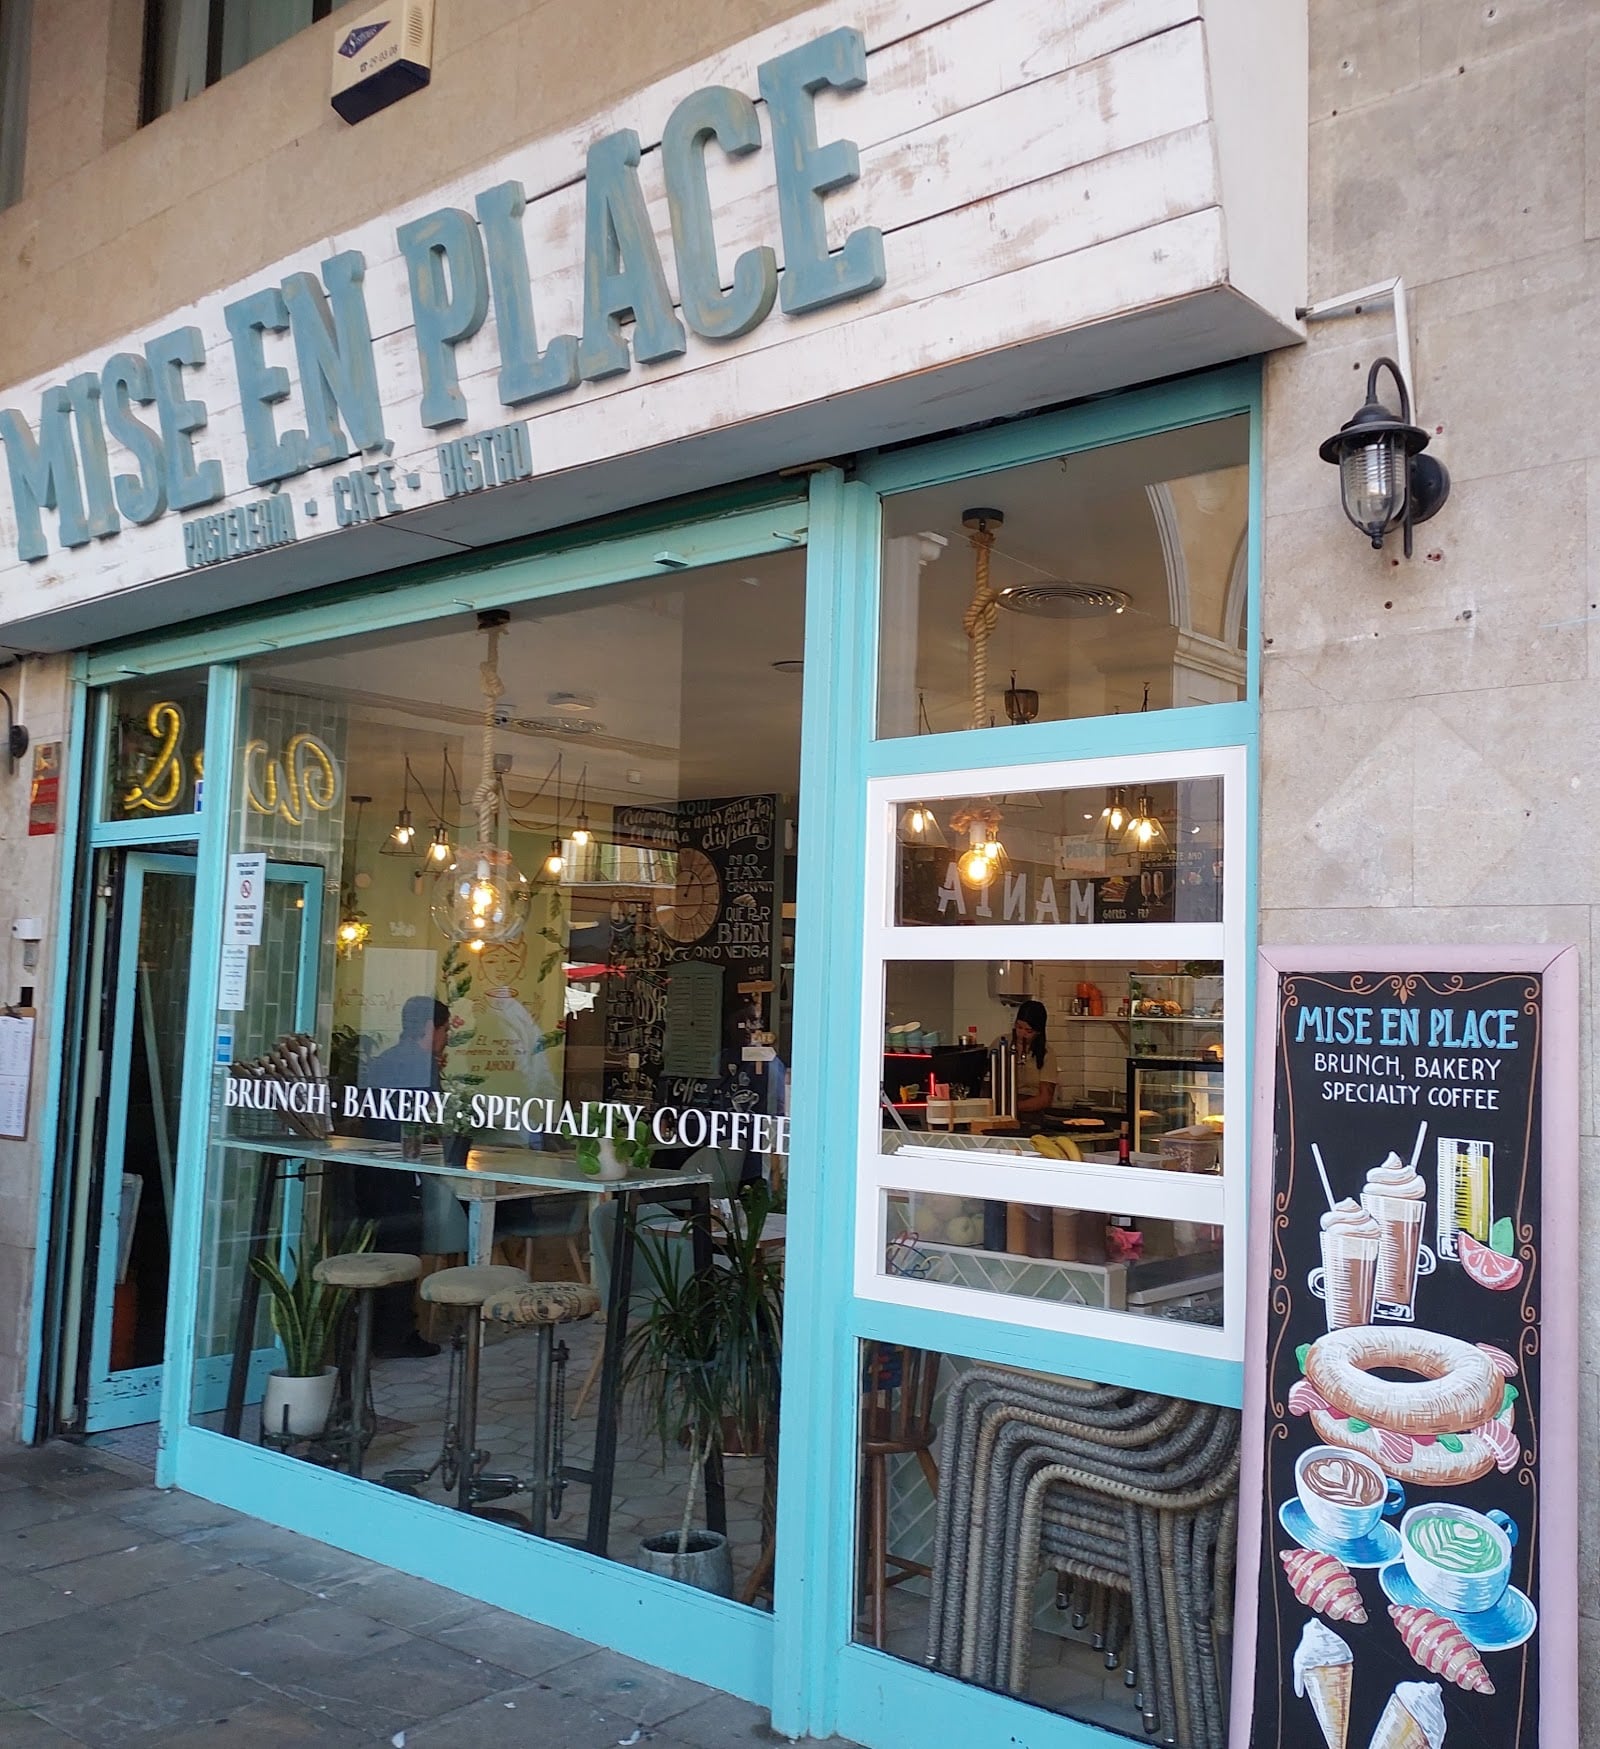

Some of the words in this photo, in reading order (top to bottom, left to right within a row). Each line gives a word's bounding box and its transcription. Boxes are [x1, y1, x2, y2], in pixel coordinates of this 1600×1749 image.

[0, 326, 224, 562] MISE
[224, 249, 387, 486] EN
[397, 26, 887, 430] PLACE
[436, 420, 534, 498] BISTRO
[724, 865, 768, 880] HAY
[728, 853, 759, 866] NO
[725, 906, 745, 922] QUE
[725, 945, 769, 959] VENGA
[1295, 1006, 1374, 1045] MISE
[1379, 1008, 1421, 1047] EN
[1427, 1008, 1519, 1050] PLACE
[1314, 1053, 1405, 1081] BRUNCH,
[1415, 1056, 1502, 1081] BAKERY
[1322, 1081, 1421, 1106] SPECIALTY
[1428, 1087, 1500, 1110] COFFEE
[224, 1077, 328, 1115] BRUNCH
[343, 1085, 452, 1125] BAKERY
[470, 1093, 645, 1141] SPECIALTY
[652, 1106, 791, 1156] COFFEE
